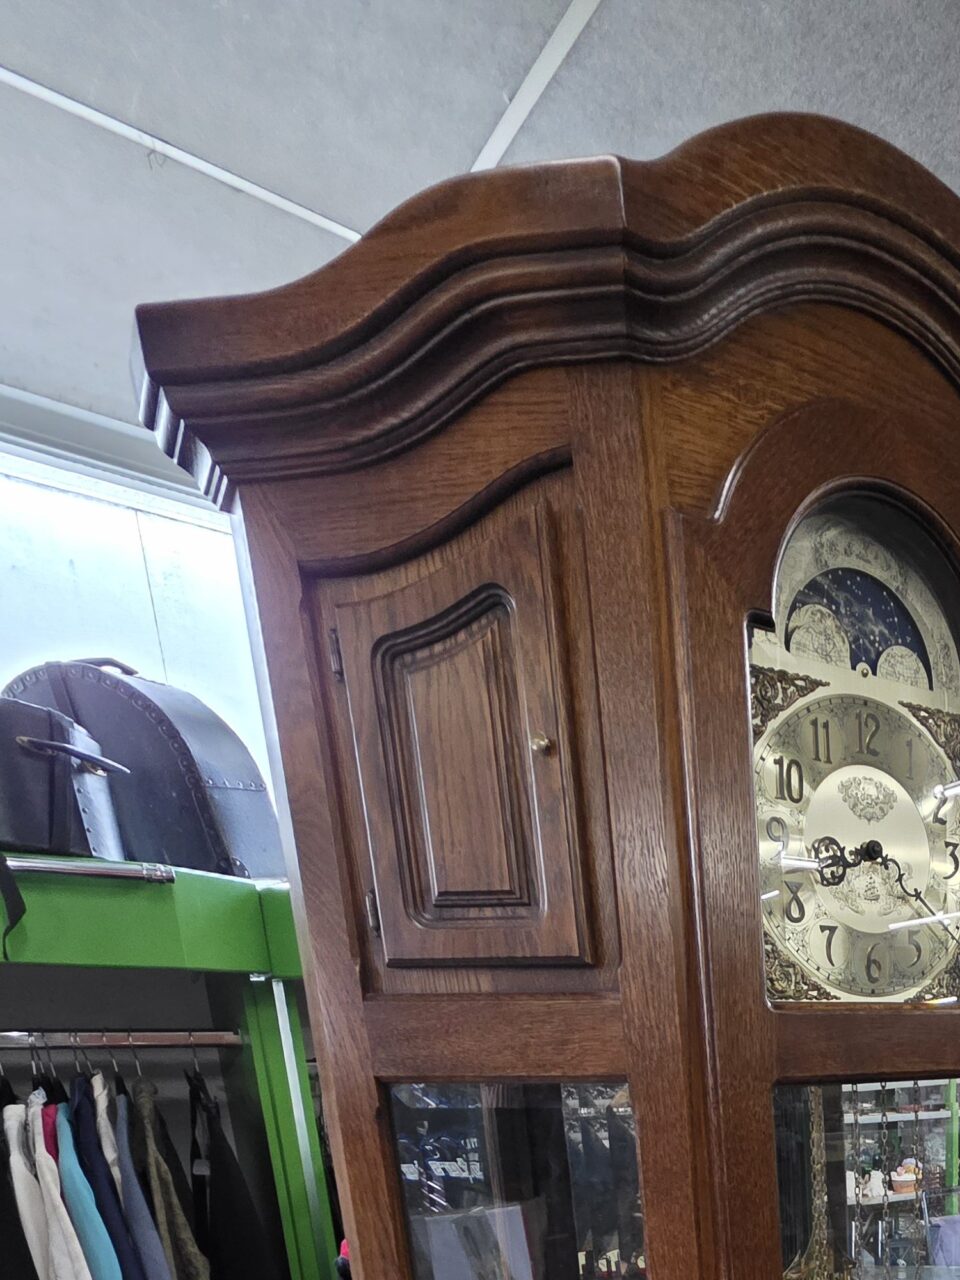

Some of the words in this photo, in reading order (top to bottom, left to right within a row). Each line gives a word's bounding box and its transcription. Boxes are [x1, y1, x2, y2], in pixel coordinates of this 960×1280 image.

[809, 716, 833, 764] 11
[855, 709, 880, 756] 12
[773, 755, 803, 803] 10
[906, 738, 914, 780] 1
[766, 816, 789, 859] 9
[942, 841, 960, 880] 3
[784, 880, 806, 924] 8
[819, 925, 838, 967] 7
[866, 943, 882, 984] 6
[907, 929, 922, 968] 5
